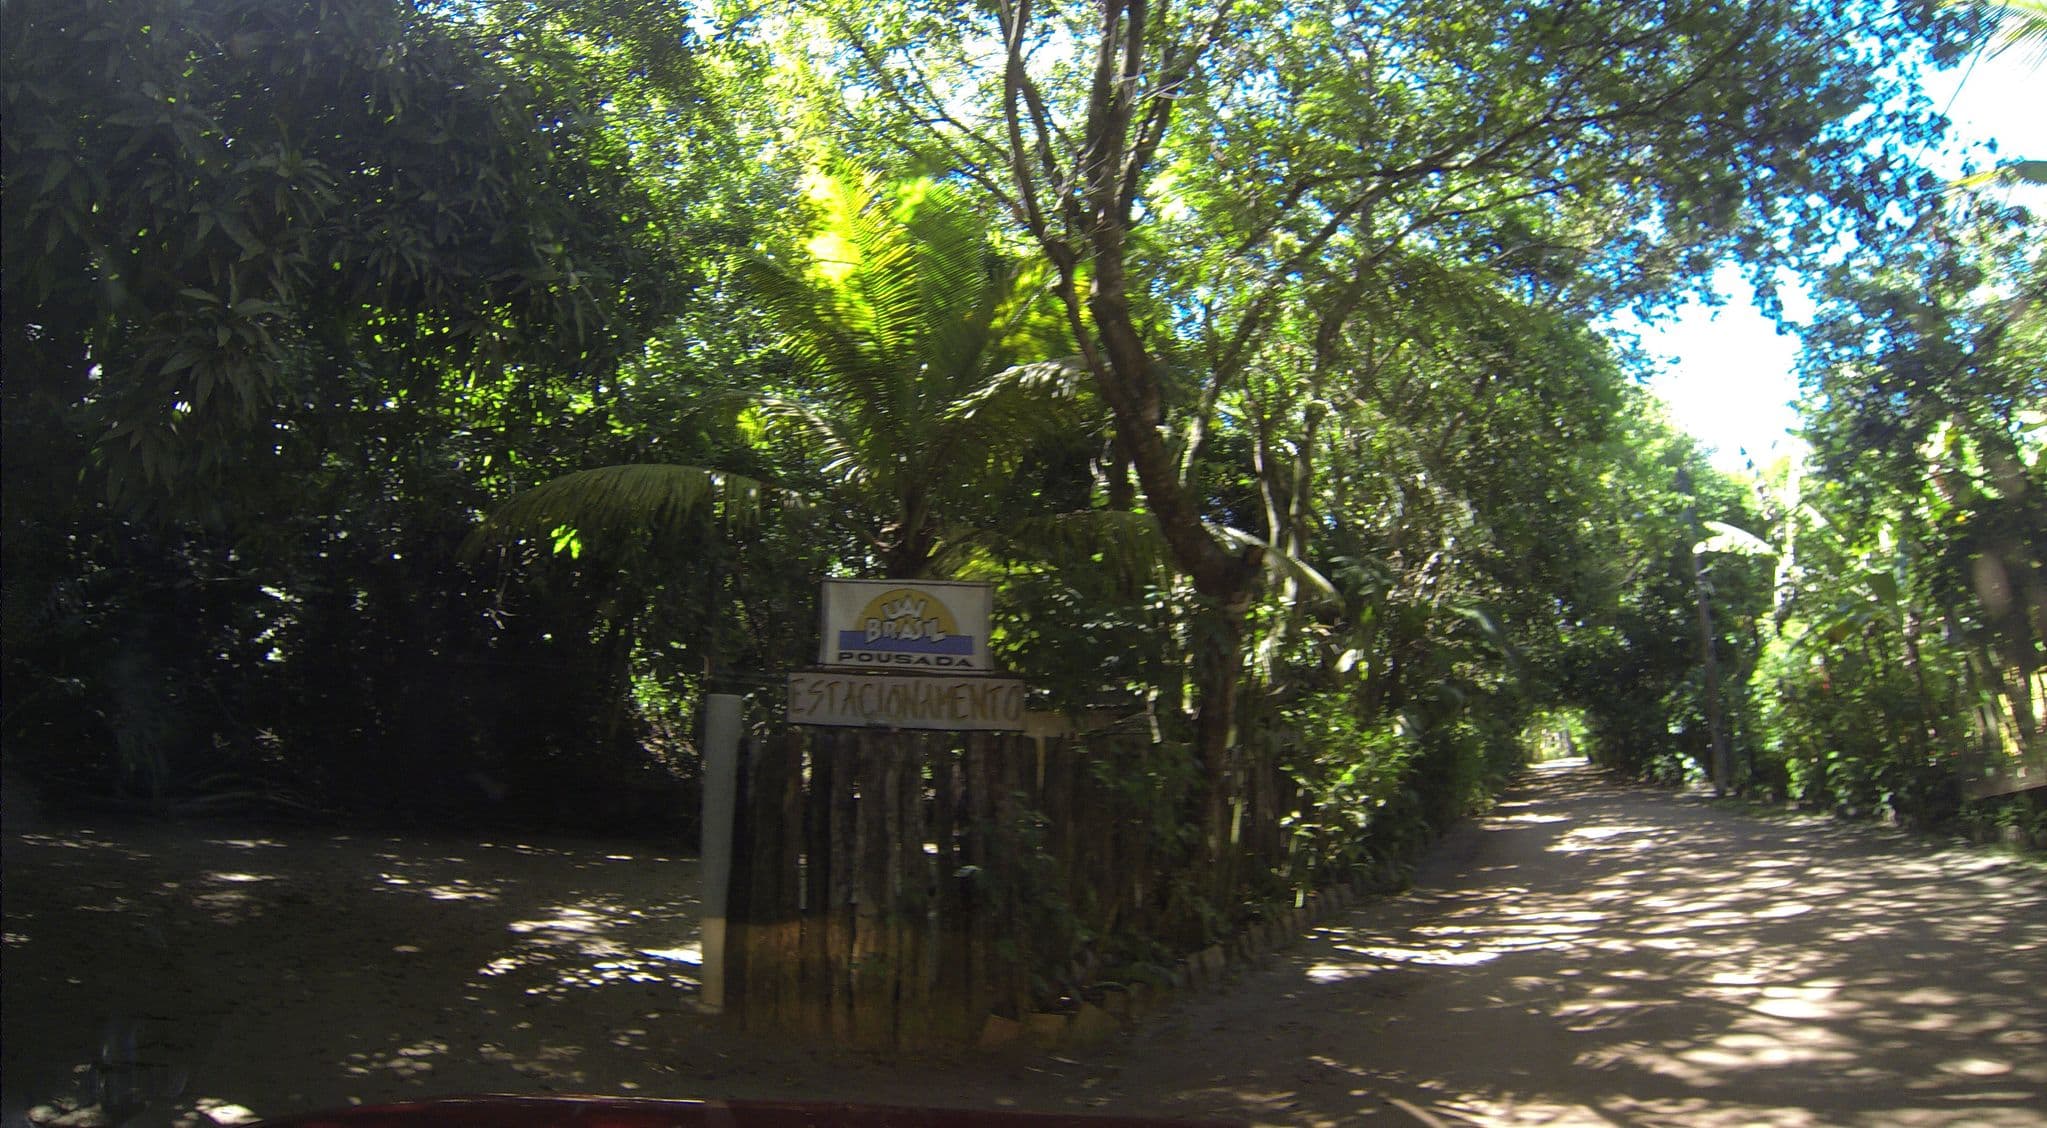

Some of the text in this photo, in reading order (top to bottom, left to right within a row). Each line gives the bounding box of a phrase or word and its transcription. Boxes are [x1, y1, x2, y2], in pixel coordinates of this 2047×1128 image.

[866, 617, 946, 644] BRASIL
[839, 652, 974, 667] POUSADA
[791, 677, 1023, 721] ESTACIONAMENTO
